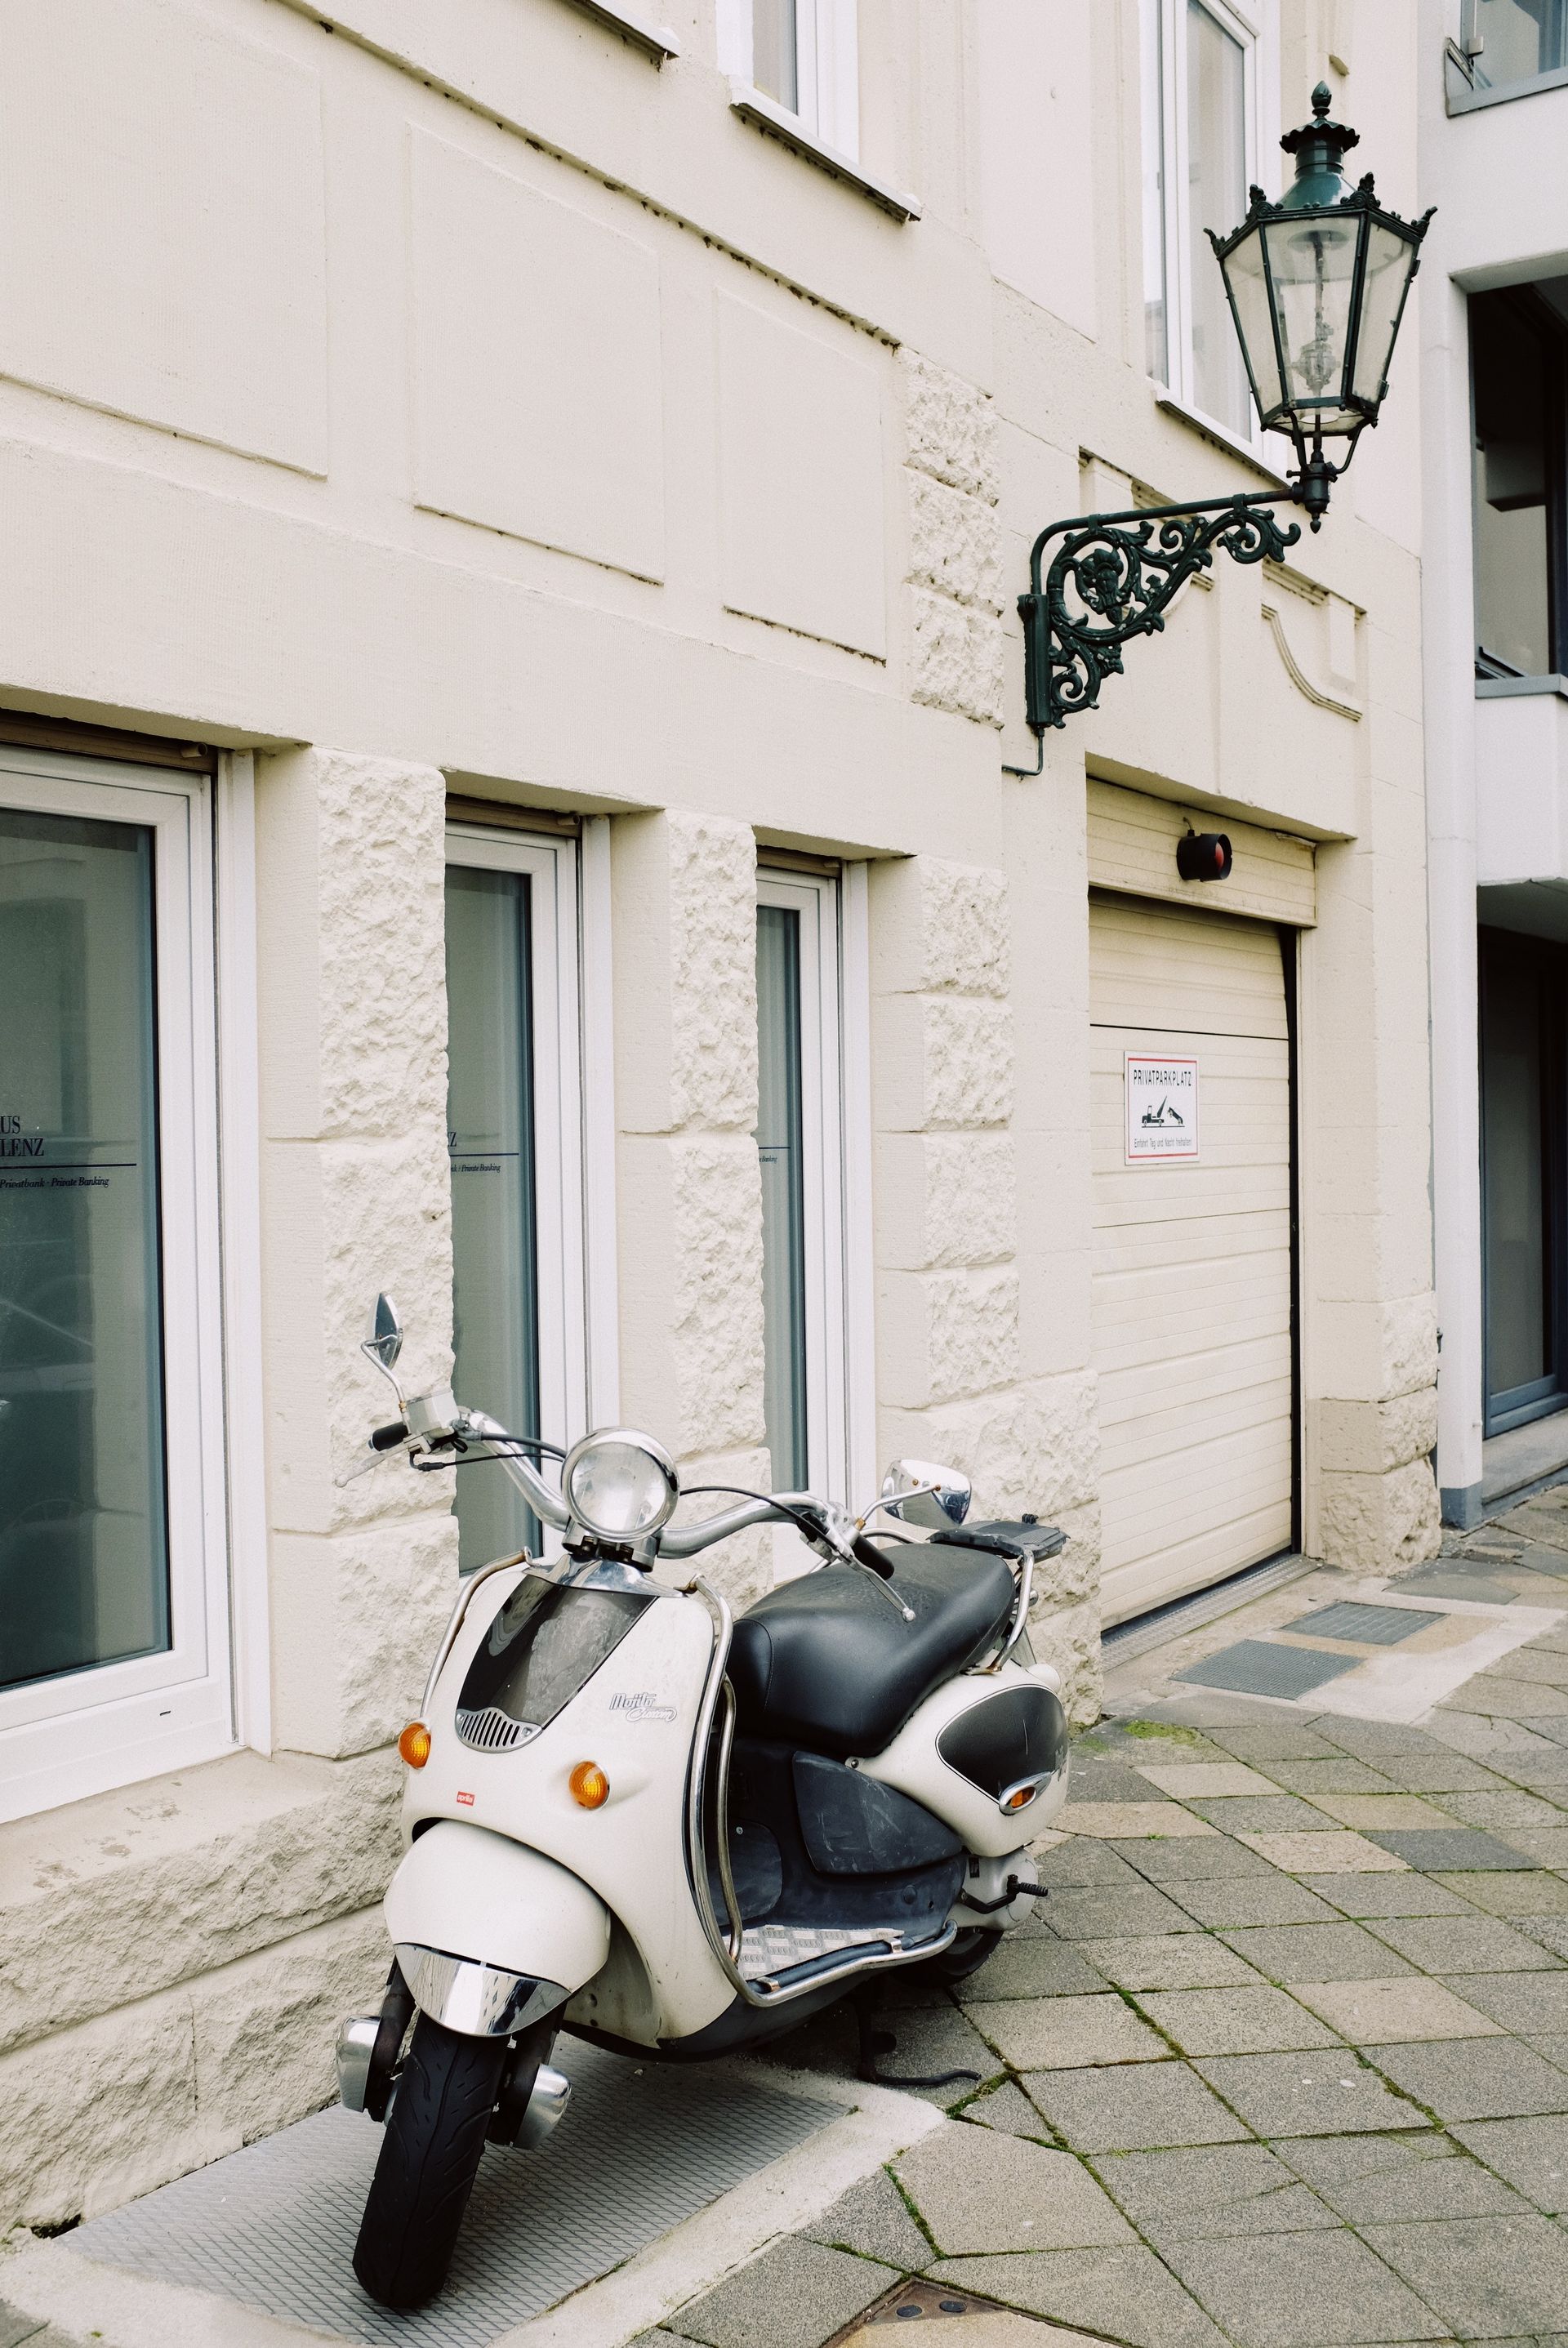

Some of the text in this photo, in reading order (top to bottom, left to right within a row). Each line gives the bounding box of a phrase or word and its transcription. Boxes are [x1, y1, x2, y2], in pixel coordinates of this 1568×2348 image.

[1133, 1069, 1192, 1087] PRIVATPARKPLATZ
[0, 1116, 21, 1134] US
[0, 1138, 45, 1156] LENZ
[1164, 1137, 1175, 1147] Nacht
[461, 1164, 479, 1173] Private
[479, 1163, 501, 1174] Banking
[0, 1176, 109, 1188] Privatbank Private Banking
[609, 1692, 657, 1710] Mojito
